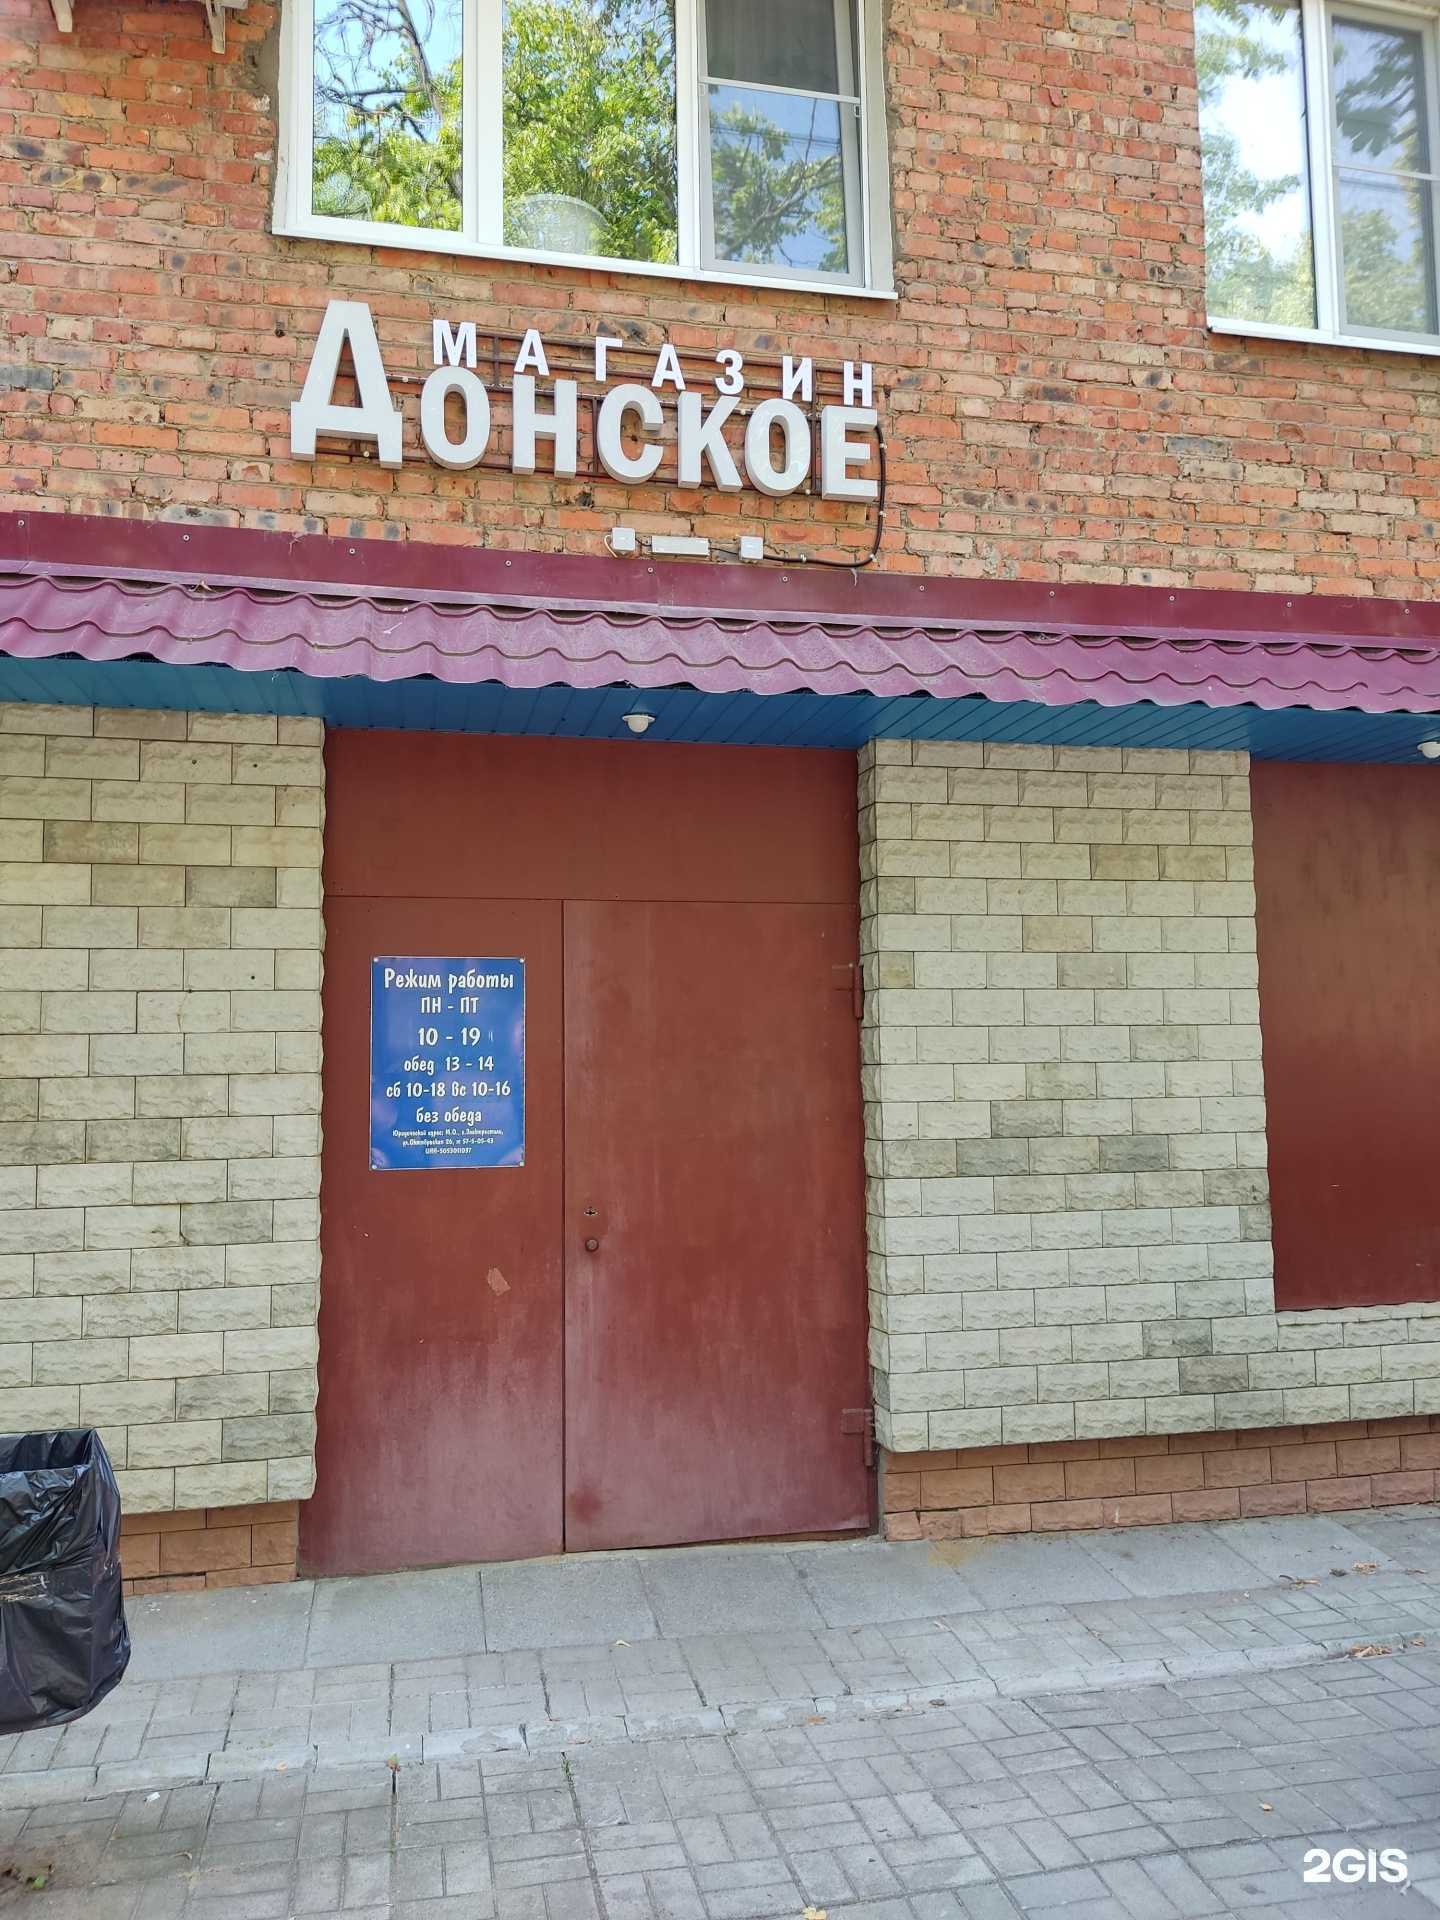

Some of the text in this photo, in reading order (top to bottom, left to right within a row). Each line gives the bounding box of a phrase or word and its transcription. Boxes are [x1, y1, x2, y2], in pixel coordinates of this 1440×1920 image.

[432, 318, 874, 408] МАГАЗИН
[384, 968, 514, 994] Режим работы
[421, 996, 442, 1014] ПН
[460, 996, 480, 1014] ПТ
[418, 1027, 438, 1046] 10
[460, 1027, 481, 1046] 19
[404, 1055, 435, 1076] обед
[445, 1056, 460, 1072] 13
[478, 1055, 494, 1072] 14
[386, 1081, 401, 1098] сб
[406, 1082, 446, 1098] 10-18
[472, 1081, 511, 1097] 10-16
[416, 1106, 482, 1127] без обеда
